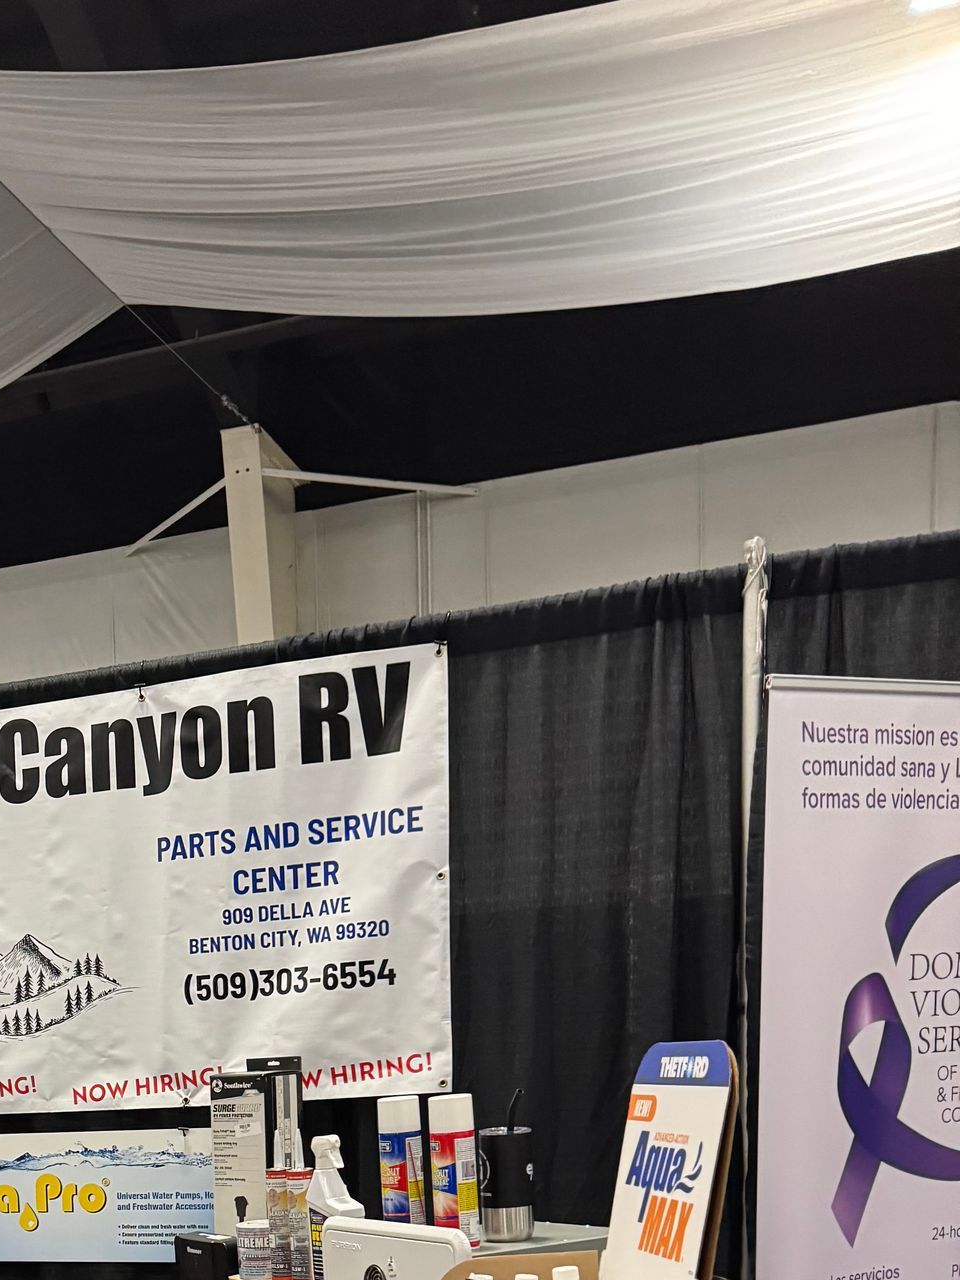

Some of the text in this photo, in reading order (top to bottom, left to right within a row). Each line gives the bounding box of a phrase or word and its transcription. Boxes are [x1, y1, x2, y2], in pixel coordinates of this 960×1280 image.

[298, 661, 410, 764] RV
[802, 721, 959, 746] Nuestra mission es
[802, 755, 896, 776] comunidad
[901, 761, 935, 778] sana
[941, 762, 951, 783] y
[802, 787, 960, 809] formas de violencia
[157, 806, 424, 862] PARTS AND SERVICE
[233, 860, 339, 895] CENTER
[222, 897, 351, 925] 909 DELLA AVE
[189, 919, 390, 954] BENTON CITY, WA 99320
[184, 959, 396, 1005] (509)303-6554
[331, 1052, 433, 1087] HIRING!
[72, 1080, 128, 1105] NOW
[213, 1104, 236, 1112] SURGE
[625, 1131, 687, 1223] Aqua
[175, 1192, 203, 1200] Pumps,
[638, 1195, 694, 1263] MAX
